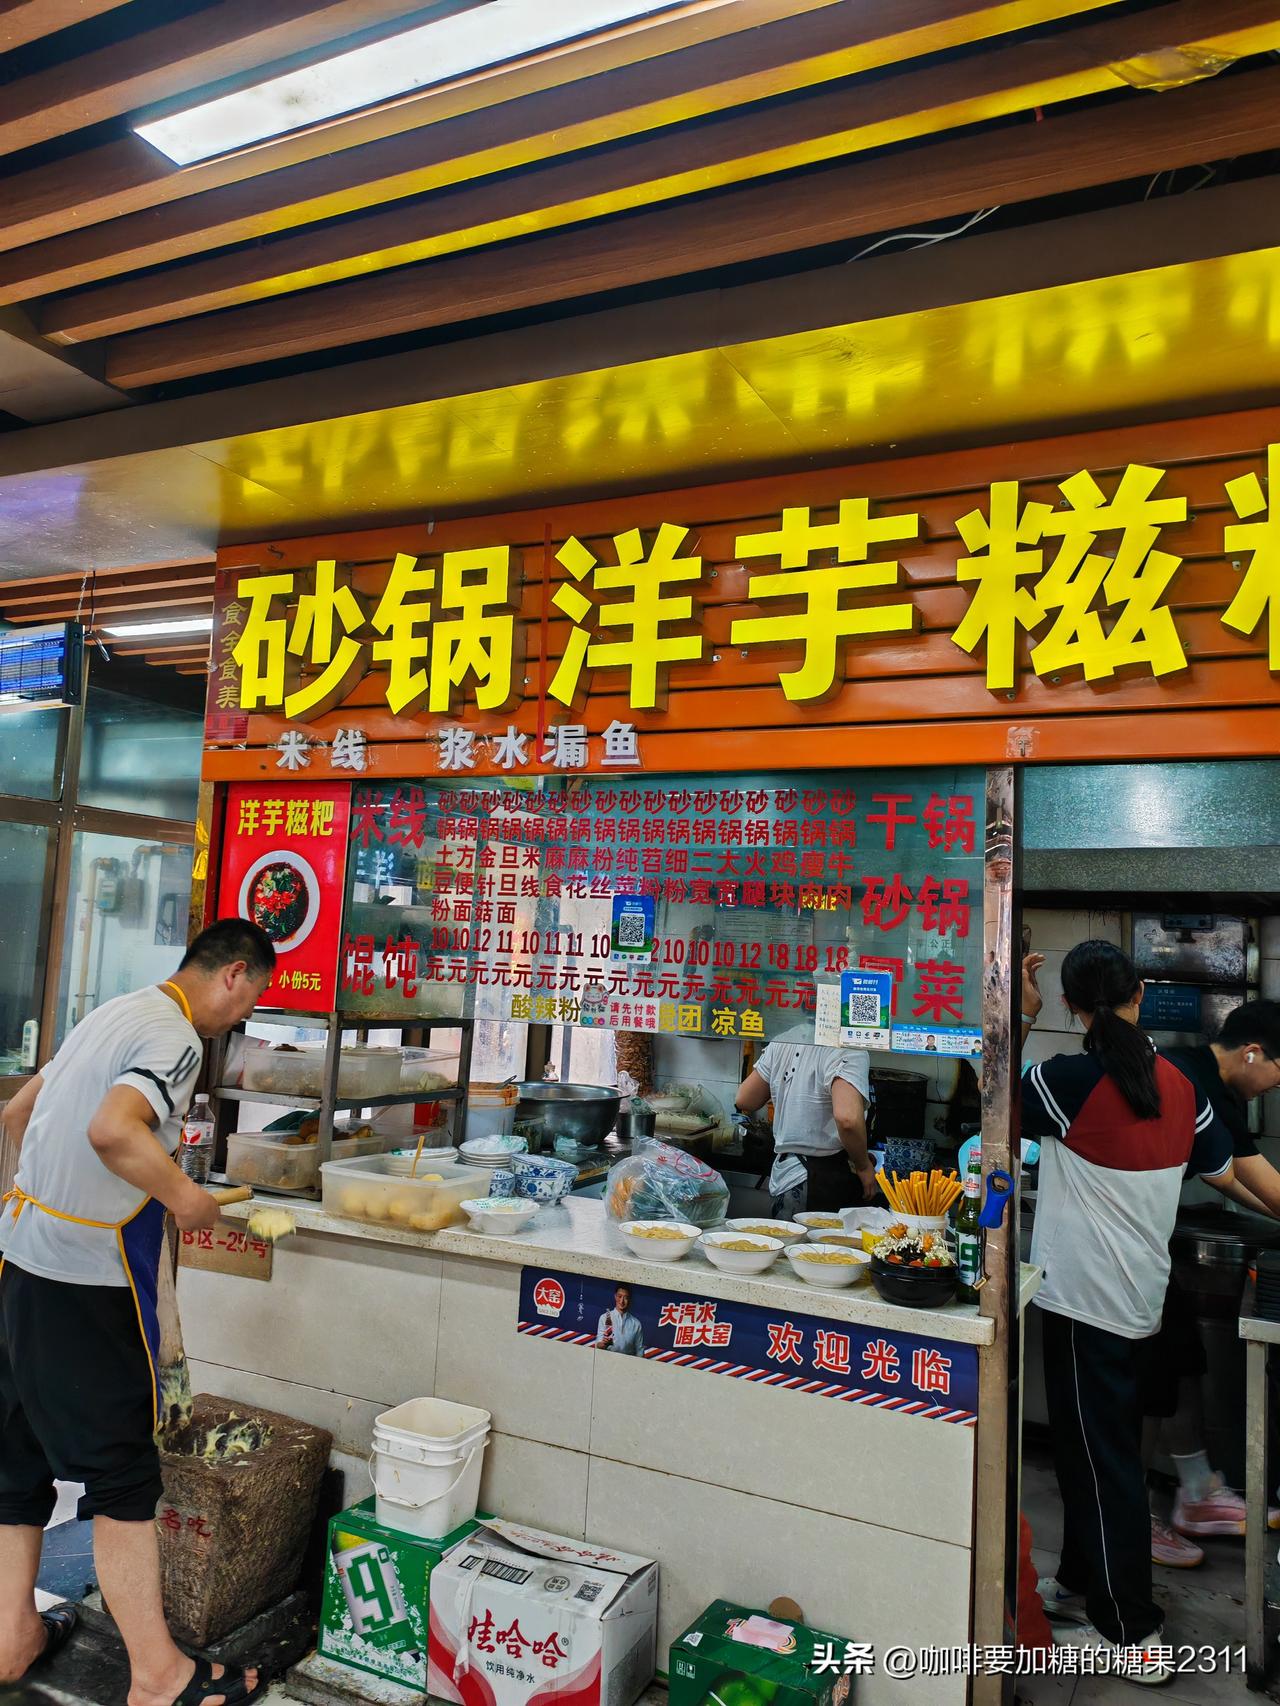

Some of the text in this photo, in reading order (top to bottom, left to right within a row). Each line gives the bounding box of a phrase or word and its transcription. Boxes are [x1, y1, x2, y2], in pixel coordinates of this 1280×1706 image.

[233, 443, 1280, 718] 砂锅洋芋糍
[276, 719, 642, 770] 米线 浆水漏鱼
[237, 799, 335, 837] 洋芋糍粑
[350, 786, 426, 848] 米线
[866, 792, 975, 854] 干锅
[860, 874, 970, 938] 砂锅
[341, 932, 419, 998] 馄饨
[511, 993, 581, 1023] 酸辣粉
[610, 1001, 656, 1015] 请先付款
[610, 1015, 656, 1028] 后用餐哦
[711, 1006, 765, 1037] 凉鱼
[537, 1287, 561, 1304] 大窑
[658, 1302, 717, 1326] 大汽水
[674, 1323, 732, 1347] 喝大窑
[766, 1322, 952, 1394] 欢迎光临
[468, 1608, 568, 1668] 娃哈哈
[485, 1660, 535, 1684] 饮用纯净水
